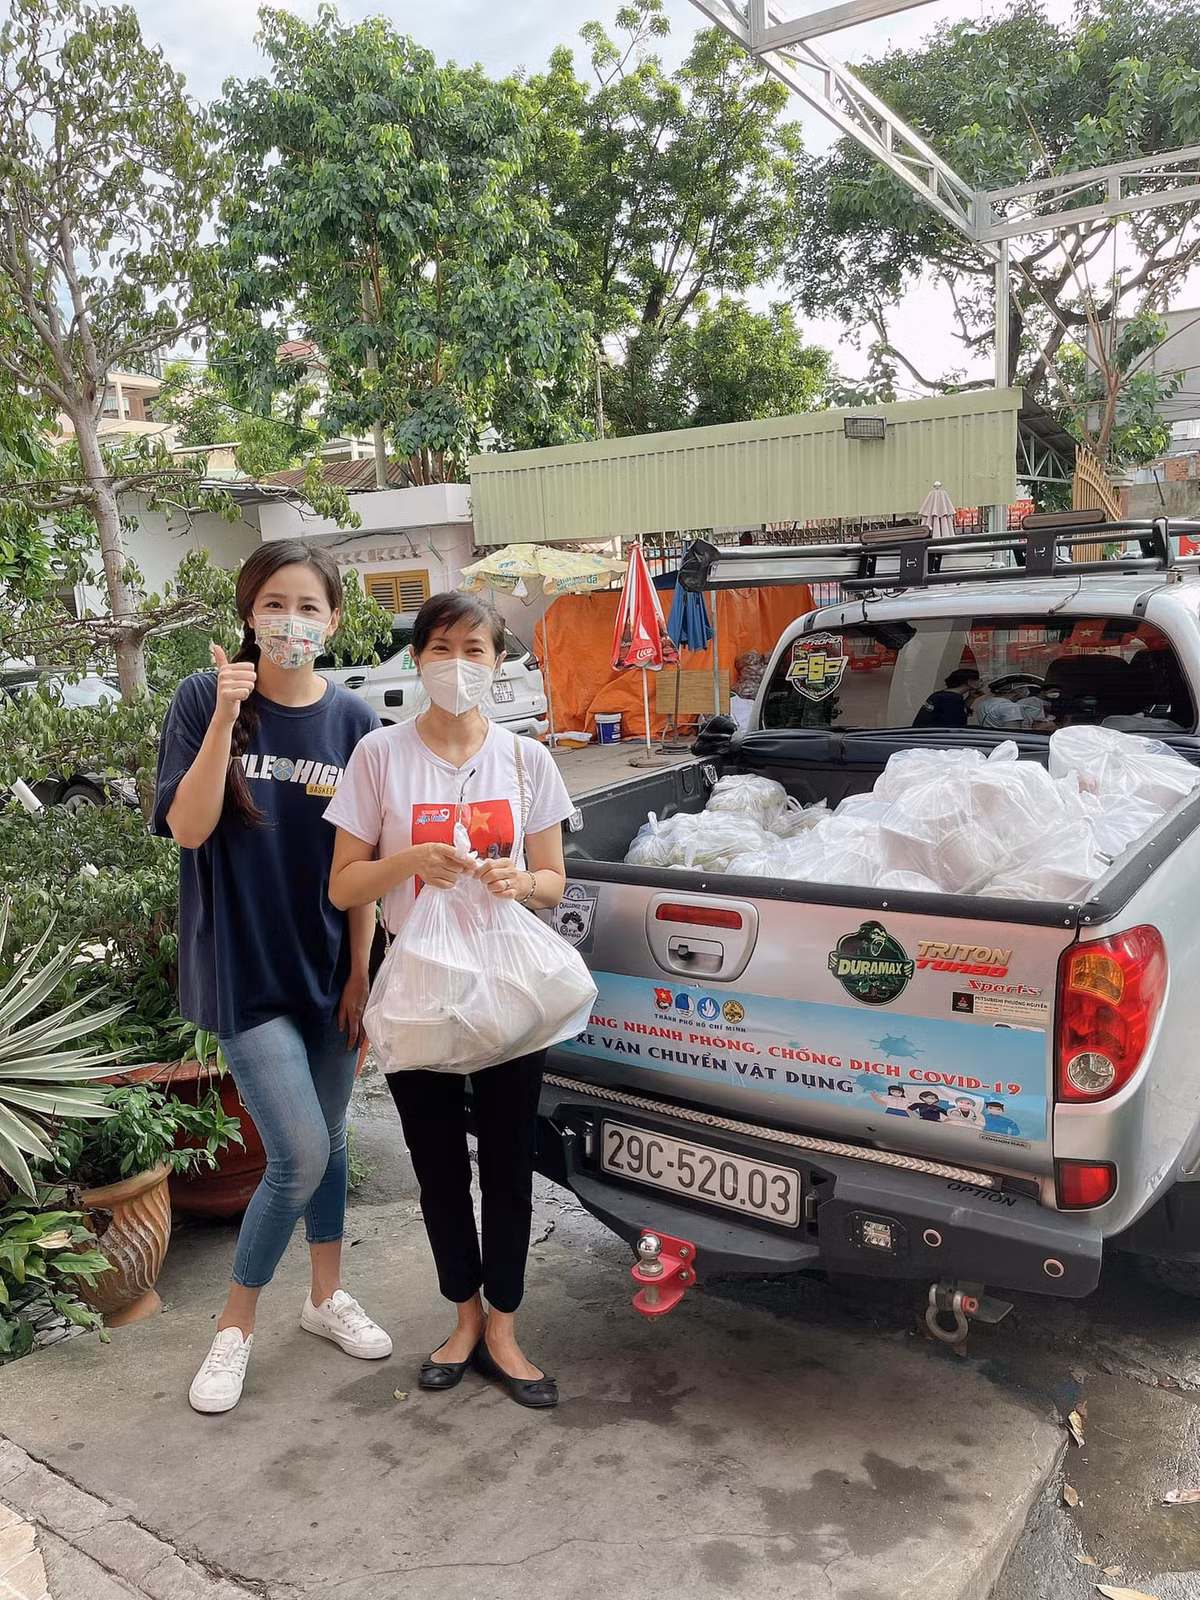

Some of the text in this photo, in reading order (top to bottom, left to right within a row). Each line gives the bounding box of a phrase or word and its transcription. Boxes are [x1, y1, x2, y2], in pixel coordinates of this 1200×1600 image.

[791, 655, 842, 681] CSC
[242, 754, 277, 780] ILE
[917, 940, 1012, 966] TRITON
[837, 959, 902, 976] DURAMAX
[916, 959, 1009, 977] TURBO
[975, 995, 1003, 1004] MITSUBISHI
[654, 1012, 677, 1023] THÀNH
[726, 1025, 746, 1033] MINH
[602, 1035, 641, 1055] VẬN
[648, 1046, 727, 1072] CHUYỂN
[734, 1056, 777, 1080] VẬT
[786, 1070, 854, 1094] DỤNG
[624, 1021, 683, 1042] NHANH
[689, 1033, 762, 1055] PHÒNG,
[768, 1045, 842, 1068] CHỐNG
[849, 1058, 901, 1078] DỊCH
[908, 1068, 1022, 1096] COVID-19
[607, 1129, 791, 1216] 29C-520.03
[947, 1181, 1018, 1207] OPTION
